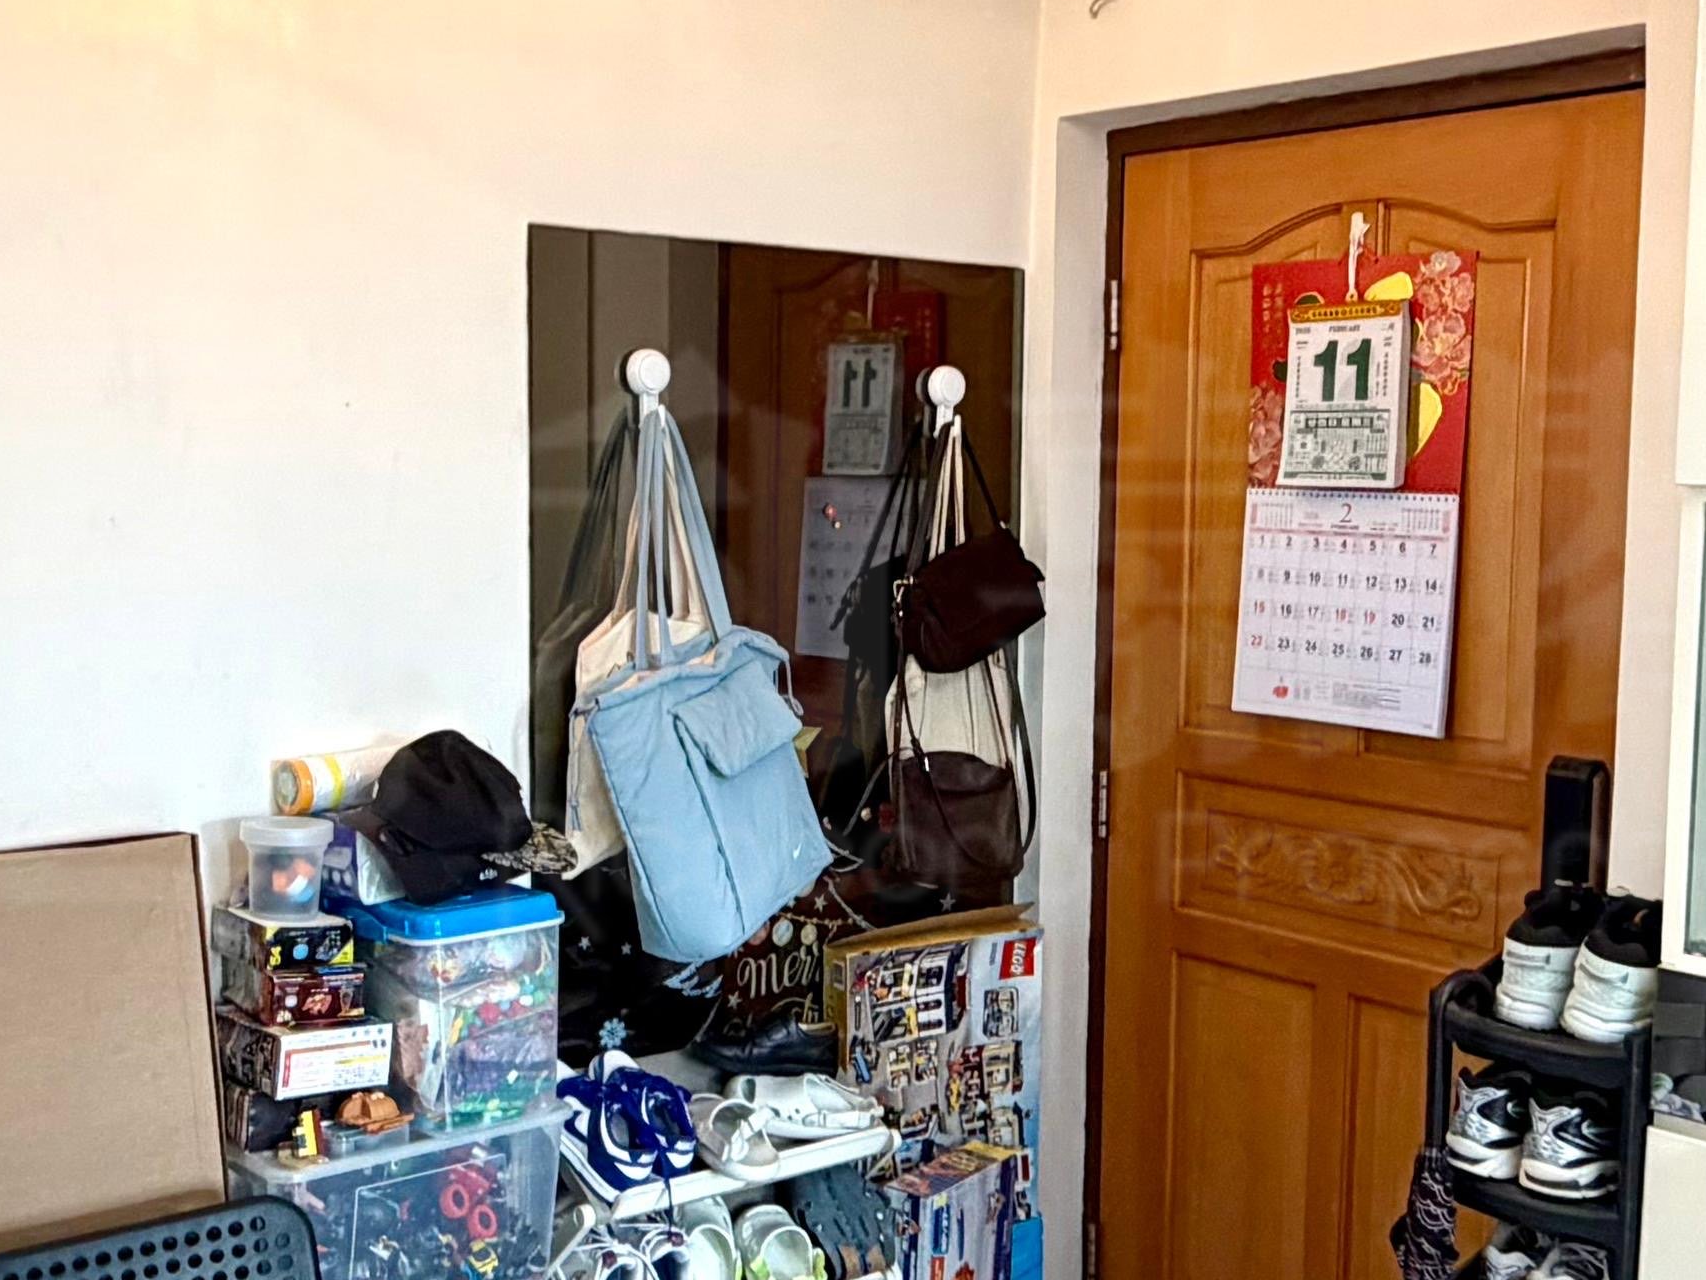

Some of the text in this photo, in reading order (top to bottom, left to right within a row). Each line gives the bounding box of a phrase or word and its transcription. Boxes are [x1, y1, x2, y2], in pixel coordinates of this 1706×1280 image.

[1314, 338, 1372, 402] 11
[1339, 503, 1352, 523] 2
[1286, 536, 1292, 547] 2
[1313, 537, 1319, 548] 3
[1341, 539, 1347, 549] 4
[1370, 540, 1376, 552] 5
[1399, 542, 1406, 553] 6
[1430, 543, 1437, 555] 7
[1284, 571, 1290, 582] 9
[1309, 572, 1321, 584] 10
[1338, 574, 1348, 586] 11
[1366, 576, 1377, 588] 12
[1395, 578, 1407, 590] 13
[1426, 580, 1437, 592] 14
[1254, 601, 1434, 628] 15 16 17 18 19 20 21
[1251, 635, 1431, 664] 22 23 24 25 26 27 28
[1011, 940, 1026, 977] LEGO
